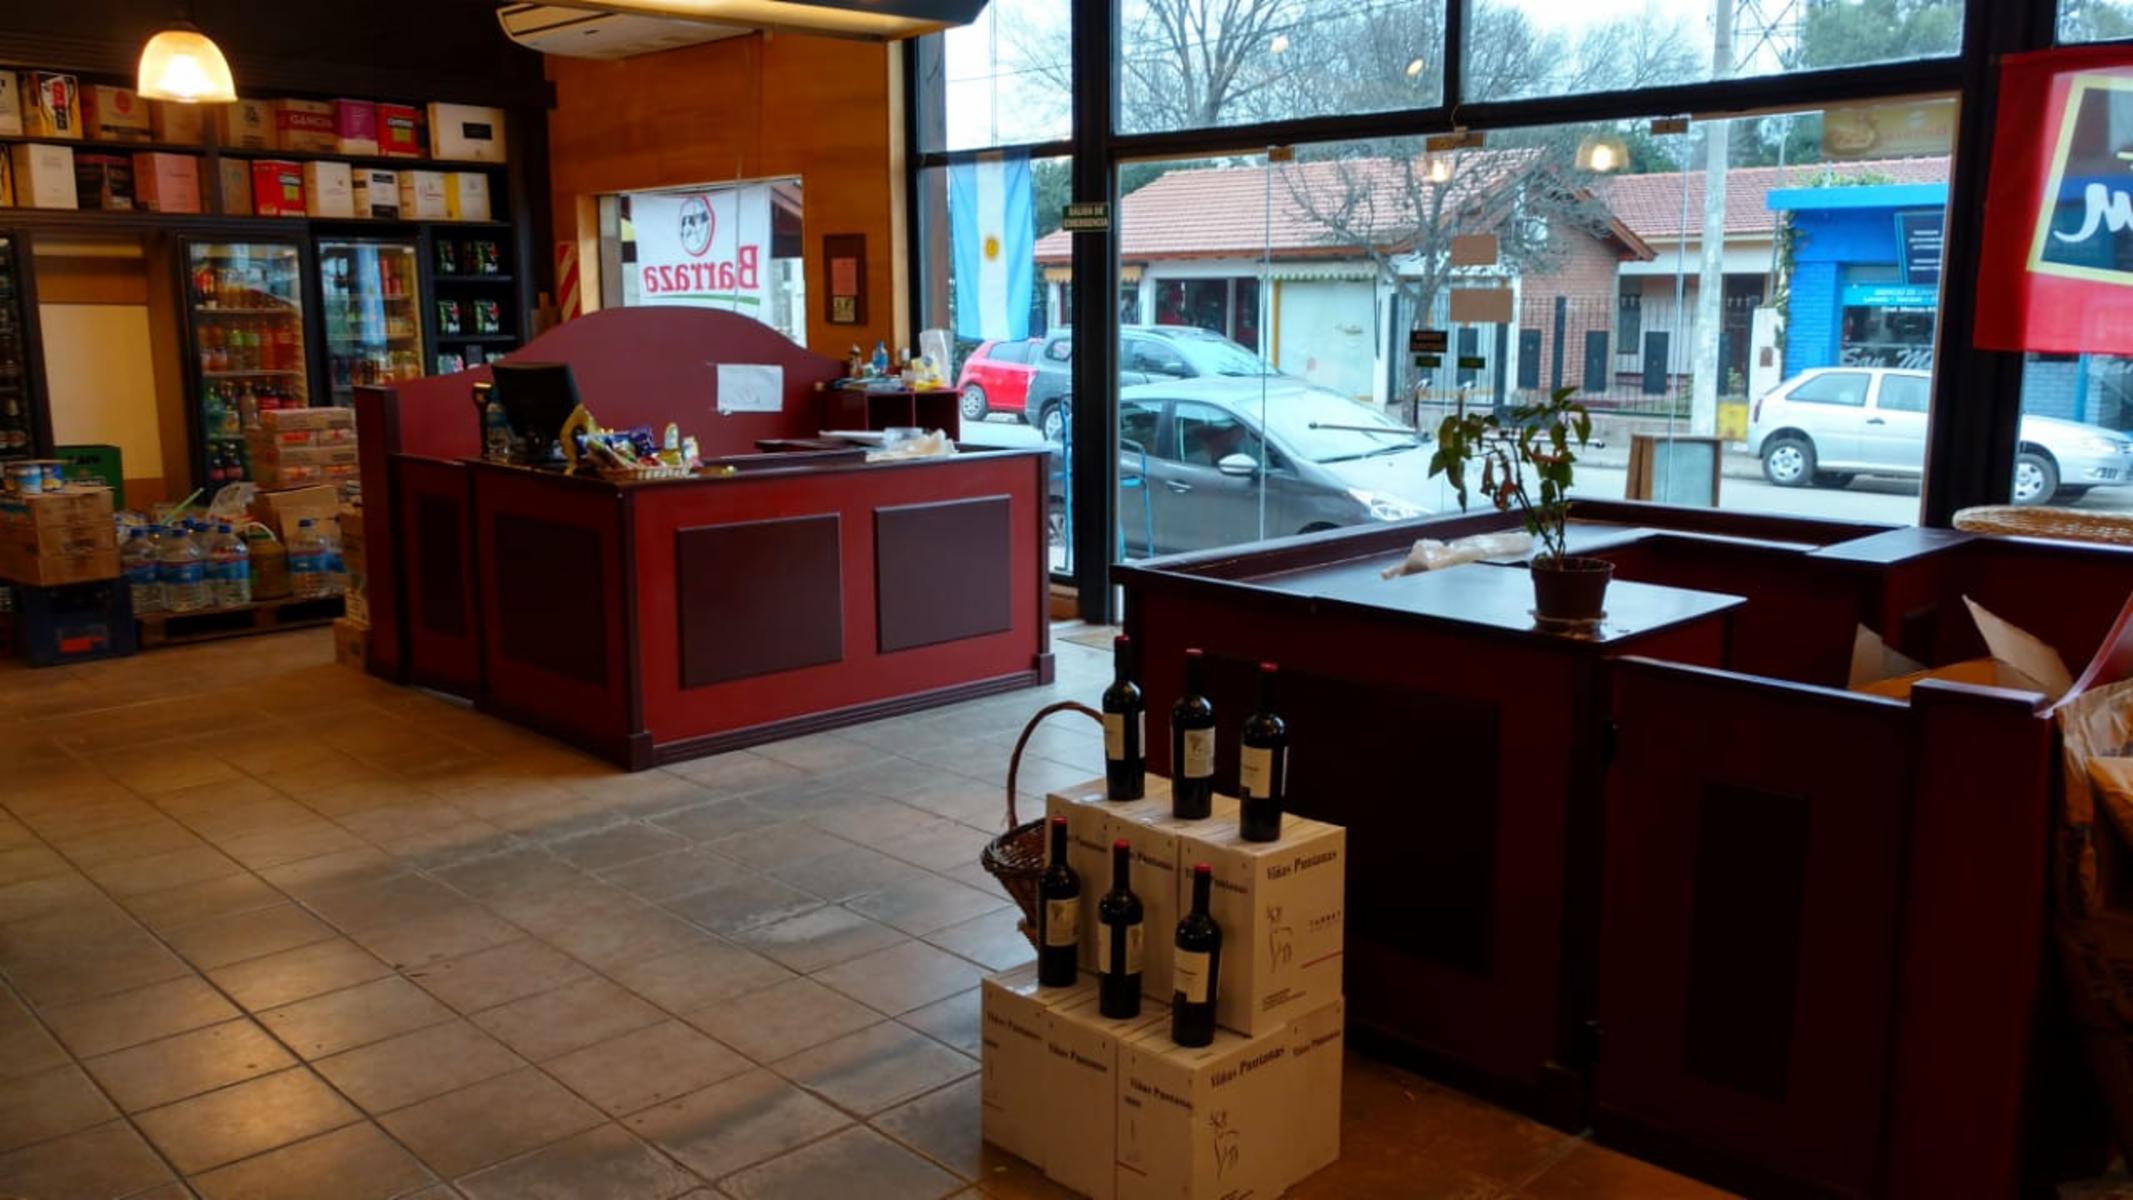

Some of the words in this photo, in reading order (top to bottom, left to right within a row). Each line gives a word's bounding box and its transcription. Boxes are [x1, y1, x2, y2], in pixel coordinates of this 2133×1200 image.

[1094, 205, 1104, 216] DE
[1843, 348, 1885, 368] San
[1897, 347, 1933, 370] M
